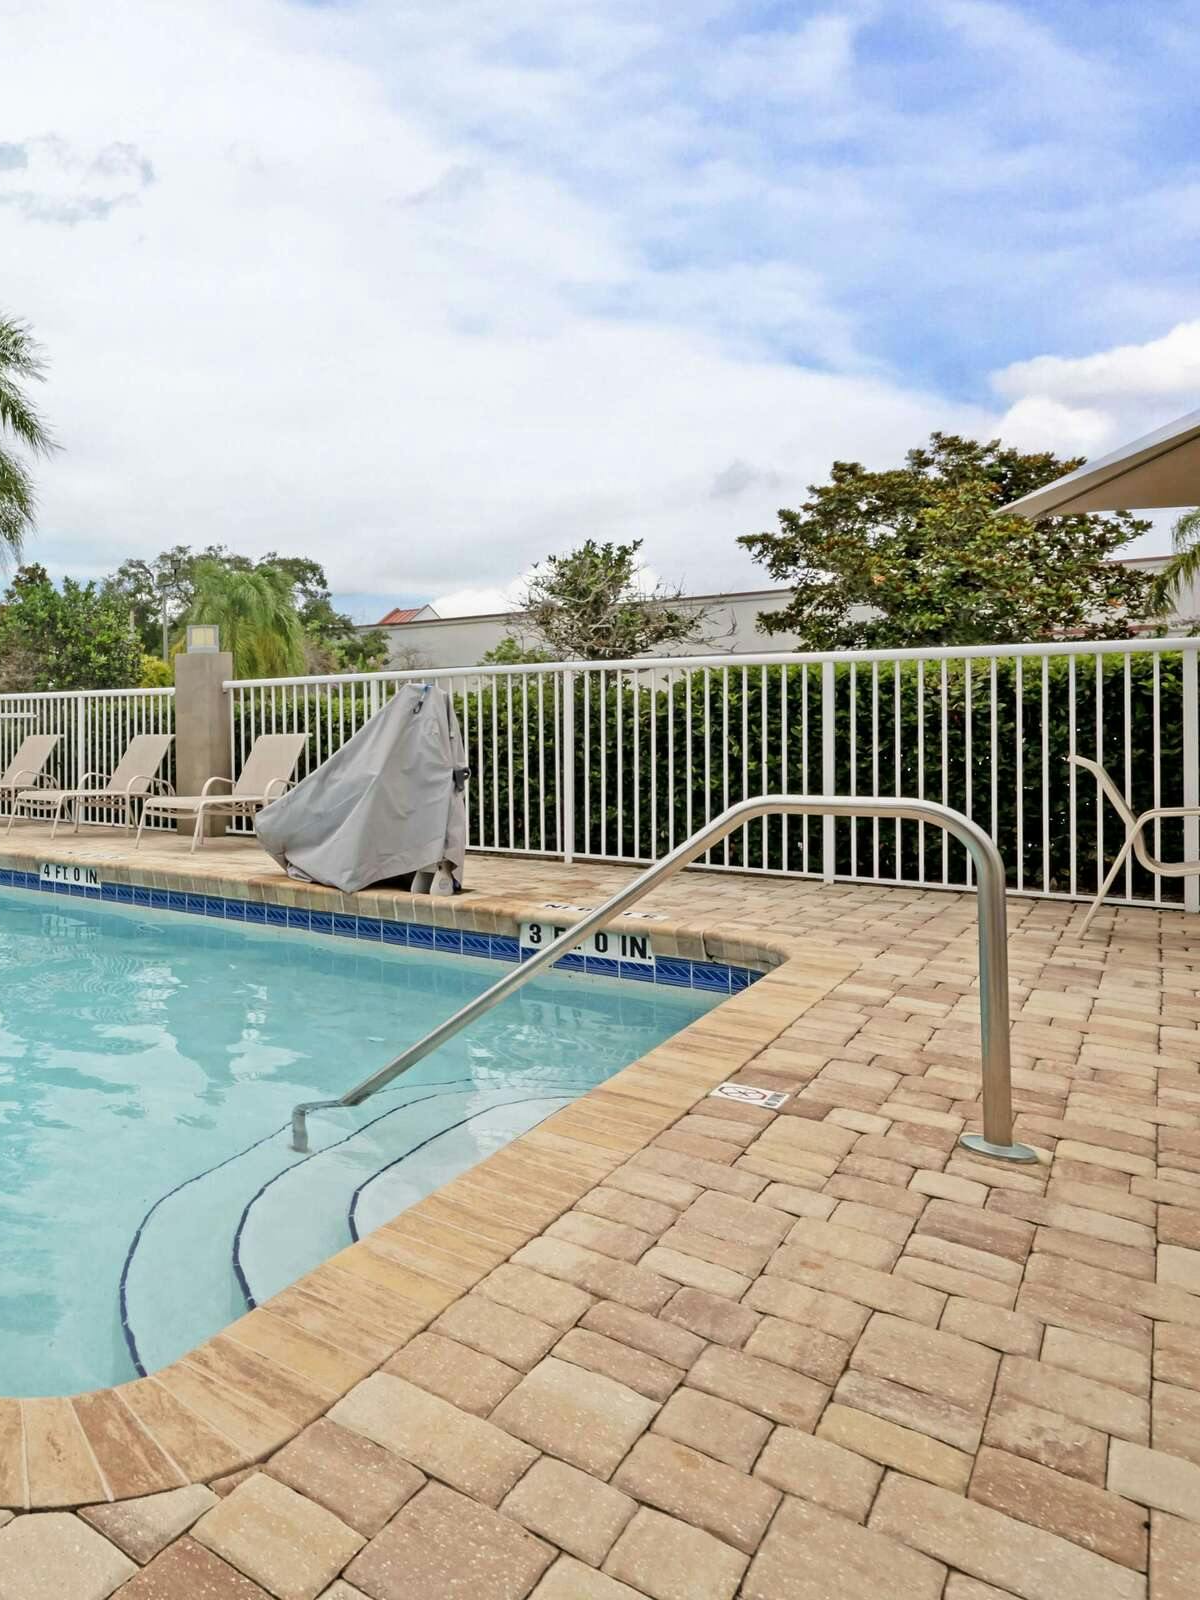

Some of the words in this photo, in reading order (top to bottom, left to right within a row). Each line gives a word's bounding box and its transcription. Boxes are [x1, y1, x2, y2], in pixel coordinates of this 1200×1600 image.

[44, 864, 50, 878] 4
[74, 867, 80, 881] 0
[529, 923, 542, 944] 3
[595, 932, 608, 953] 0
[621, 935, 652, 960] IN.
